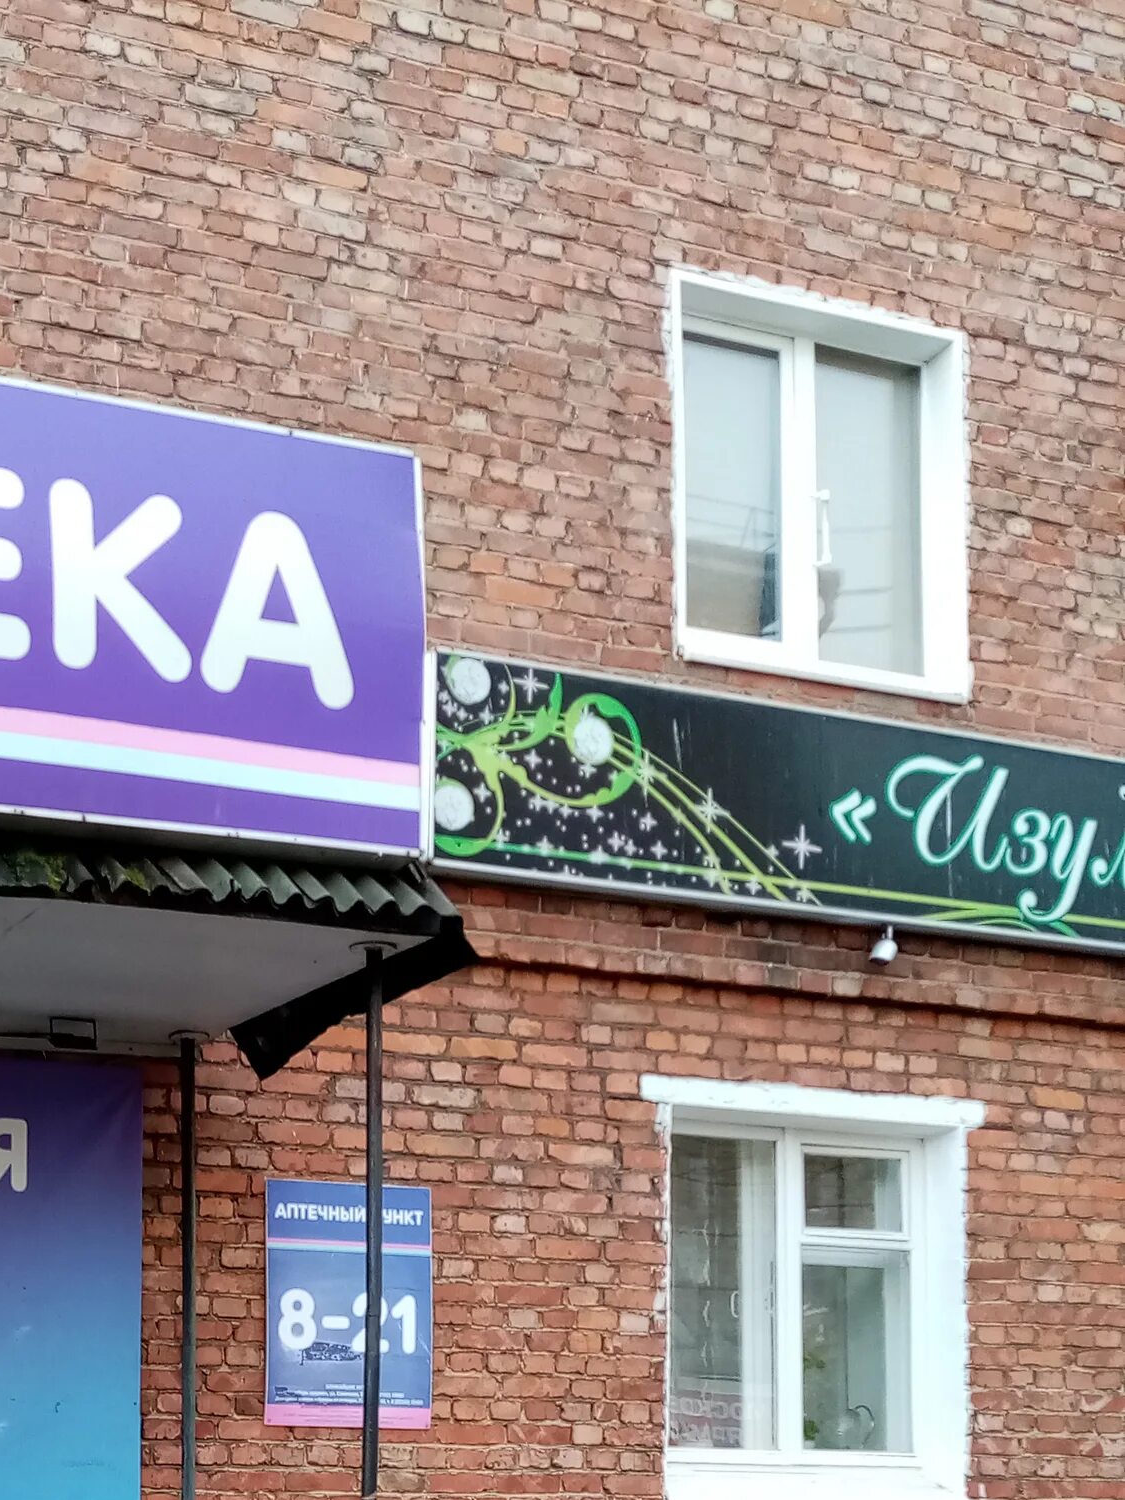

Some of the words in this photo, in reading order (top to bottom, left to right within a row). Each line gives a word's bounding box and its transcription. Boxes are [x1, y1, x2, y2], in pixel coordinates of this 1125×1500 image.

[274, 1202, 367, 1223] АПТЕЧНЫЙ
[382, 1208, 424, 1226] УНКТ
[278, 1288, 417, 1355] 8-21
